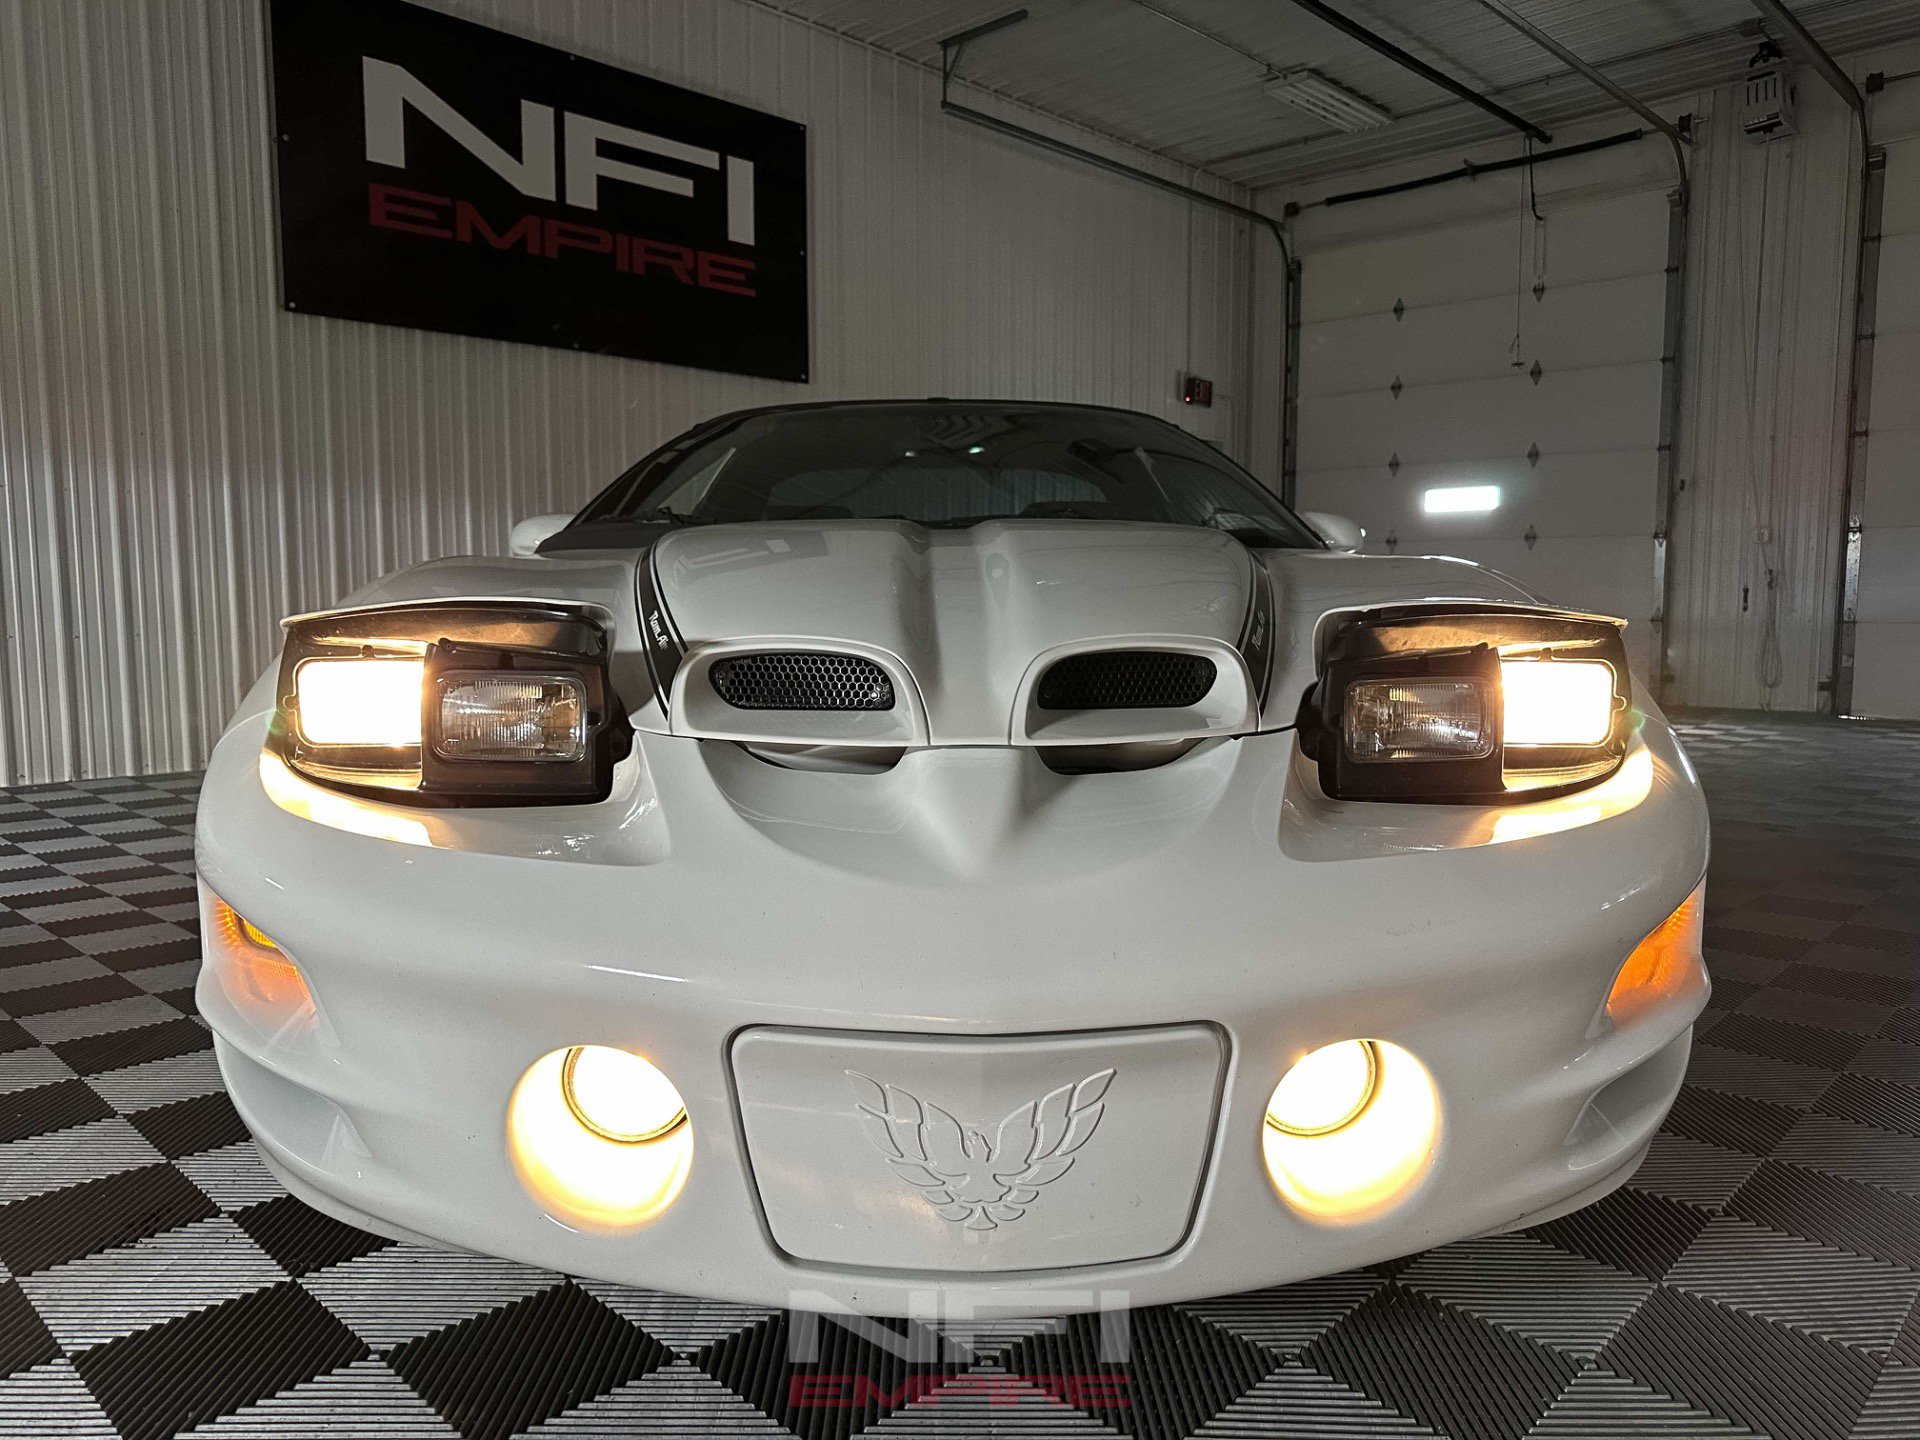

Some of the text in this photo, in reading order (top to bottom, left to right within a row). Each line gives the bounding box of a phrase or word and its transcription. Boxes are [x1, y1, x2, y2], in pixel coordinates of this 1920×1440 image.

[362, 55, 755, 246] NFI
[368, 182, 757, 297] EMPIRE
[648, 610, 661, 638] Ram
